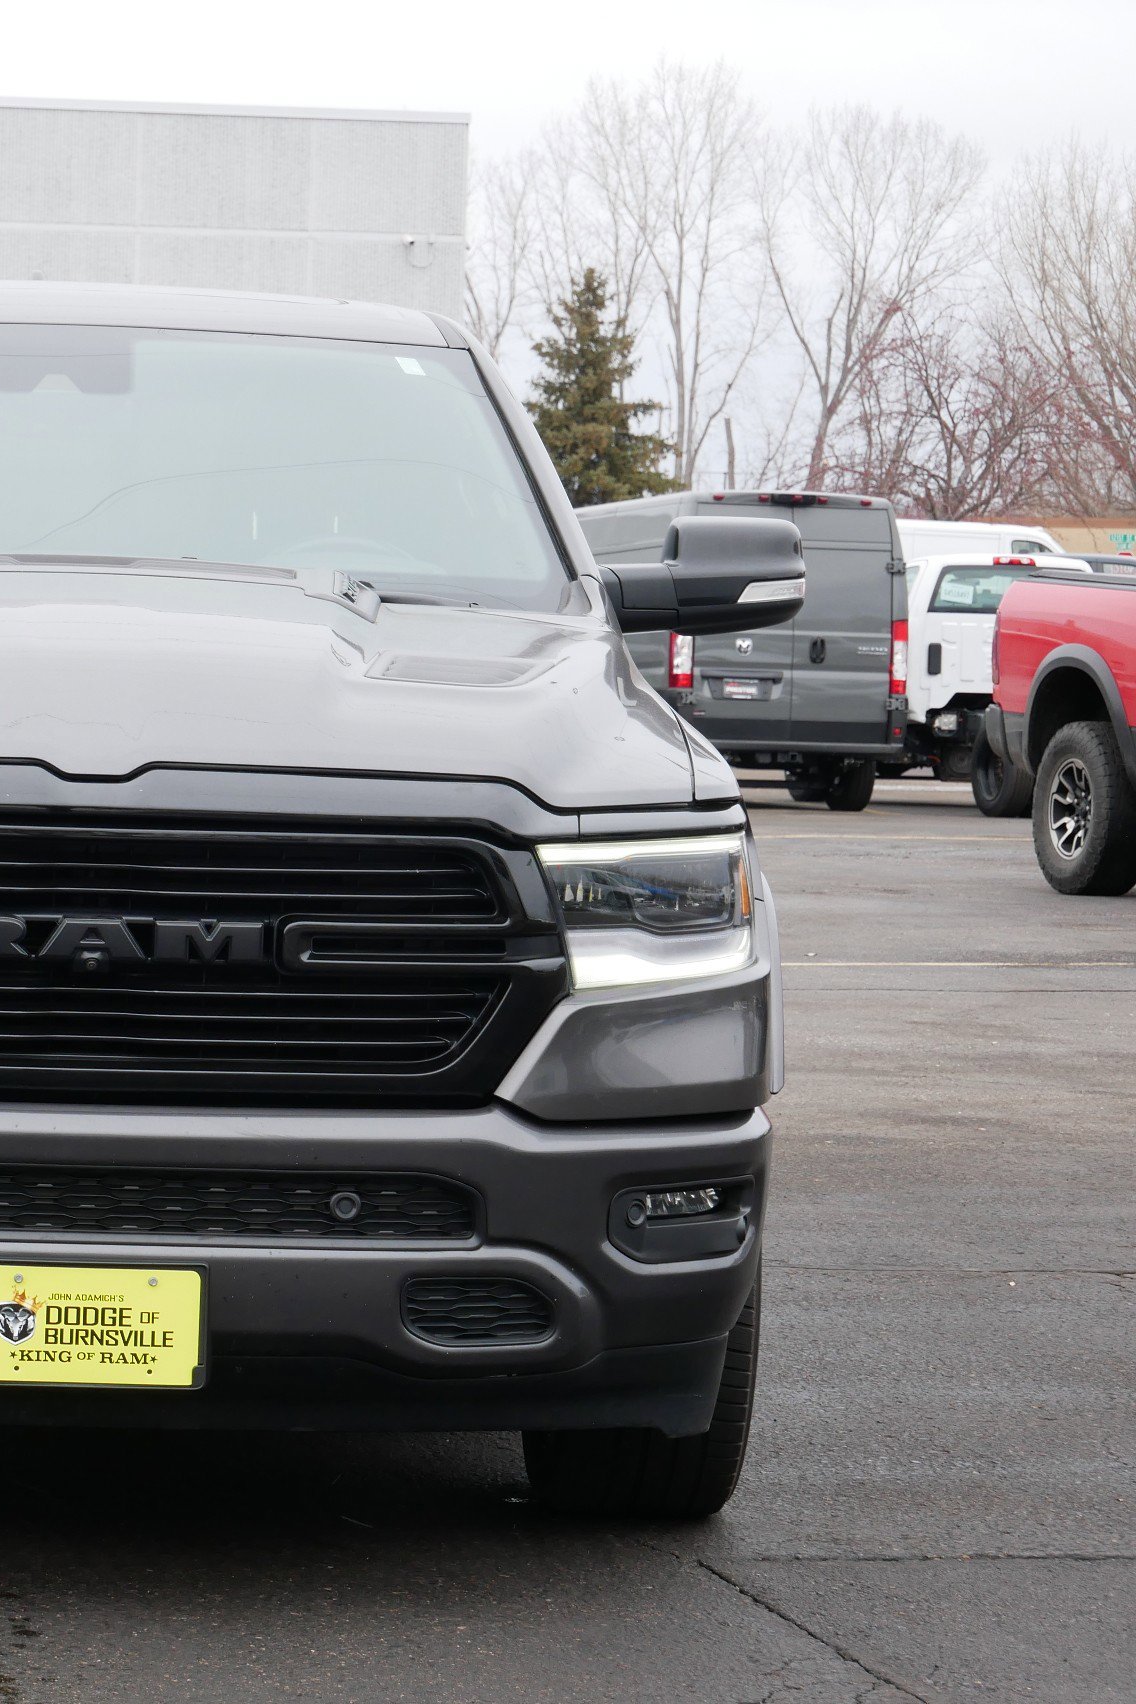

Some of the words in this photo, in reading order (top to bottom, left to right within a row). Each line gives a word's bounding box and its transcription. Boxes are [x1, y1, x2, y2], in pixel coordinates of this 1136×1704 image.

[48, 1292, 72, 1301] JOHN
[75, 1293, 125, 1303] ADAMICH'S
[45, 1305, 132, 1327] DODGE
[140, 1311, 160, 1325] OF
[44, 1328, 174, 1348] BURNSVILLE
[18, 1349, 72, 1363] KING
[77, 1351, 96, 1361] OF
[99, 1351, 149, 1365] RAM
